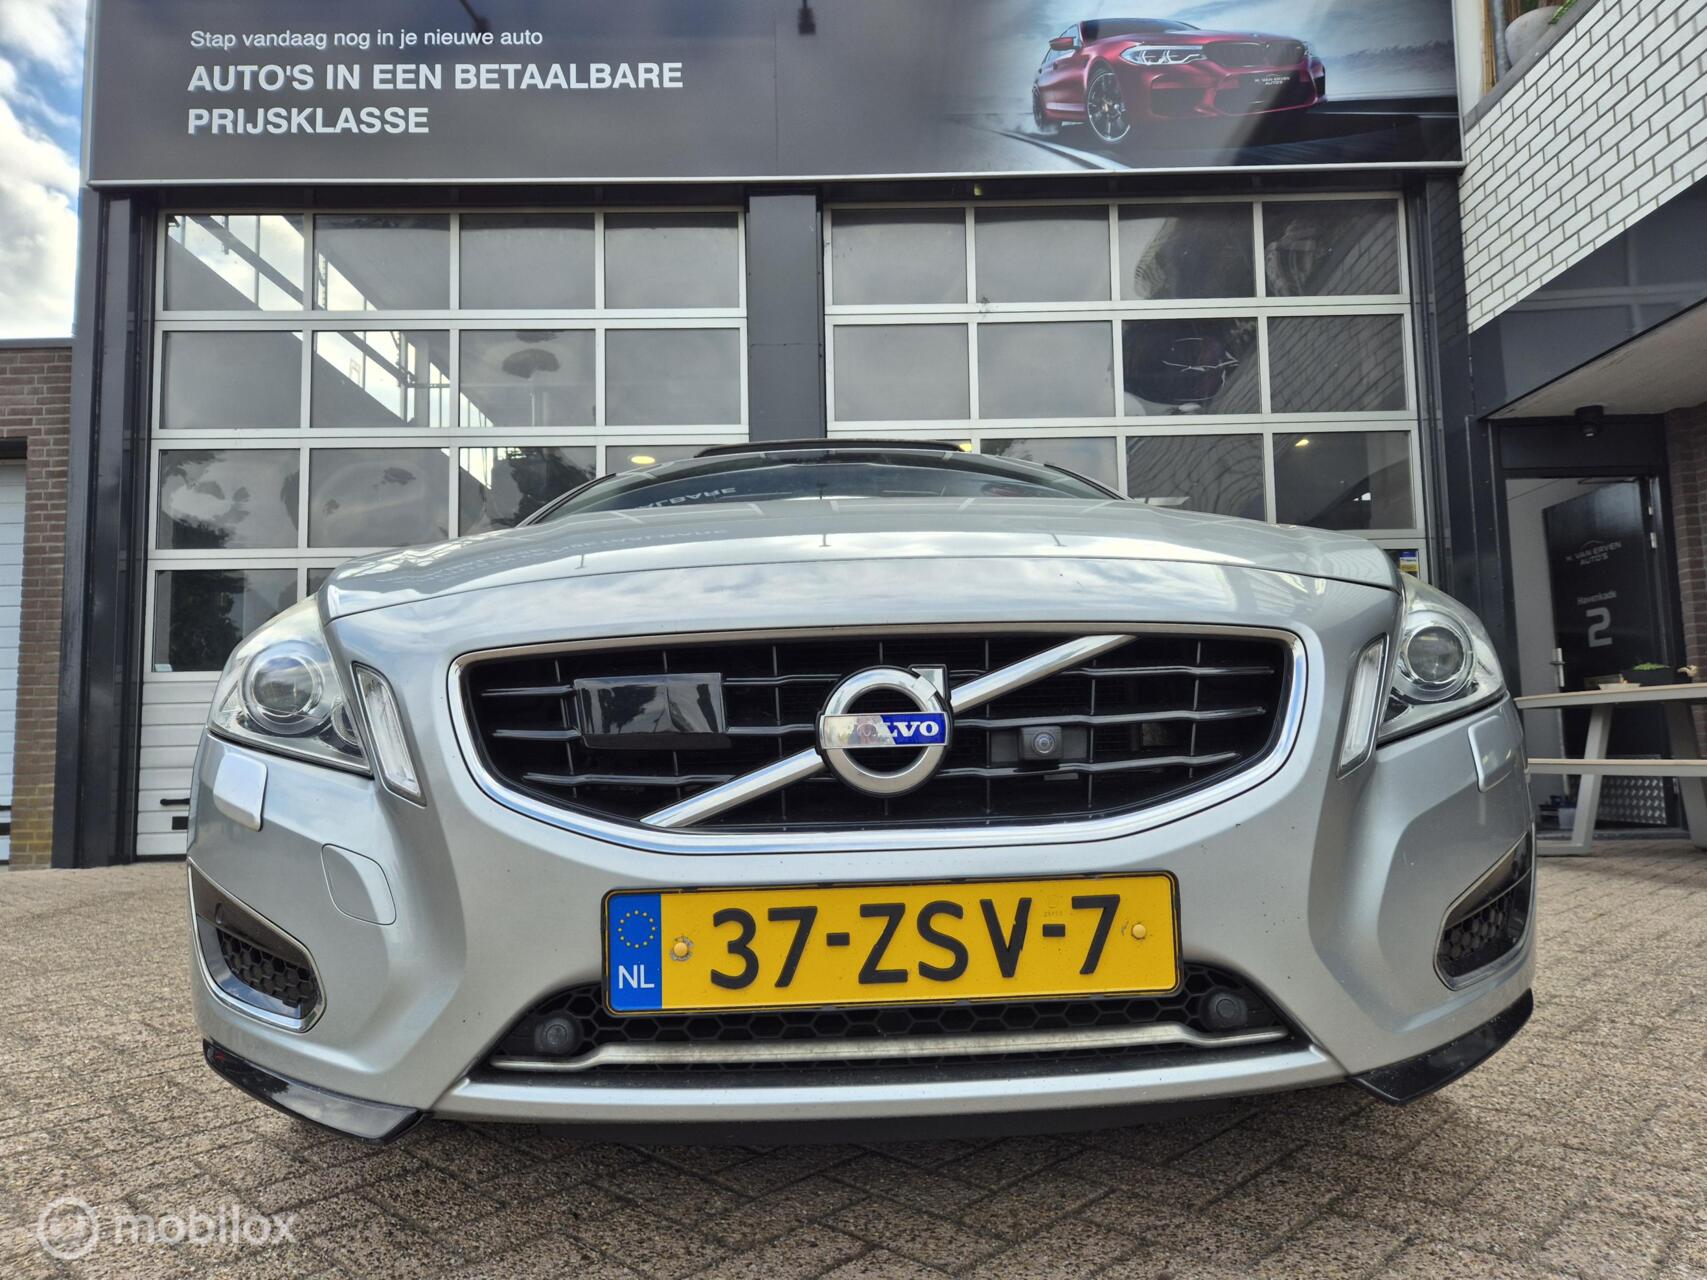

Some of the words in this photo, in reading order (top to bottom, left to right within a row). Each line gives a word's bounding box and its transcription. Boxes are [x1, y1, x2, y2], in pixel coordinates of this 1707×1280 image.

[190, 30, 236, 50] Stap
[242, 30, 327, 49] vandaag
[334, 32, 370, 49] nog
[377, 29, 394, 45] in
[400, 29, 418, 49] je
[424, 29, 494, 45] nieuwe
[500, 29, 543, 45] auto
[187, 63, 314, 92] AUTO'S
[326, 64, 360, 90] IN
[373, 63, 442, 90] EEN
[455, 62, 683, 90] BETAALBARE
[187, 106, 430, 135] PRIJSKLASSE
[1586, 607, 1613, 648] 2
[710, 893, 1121, 990] 37-ZSV-7
[618, 965, 654, 990] NL
